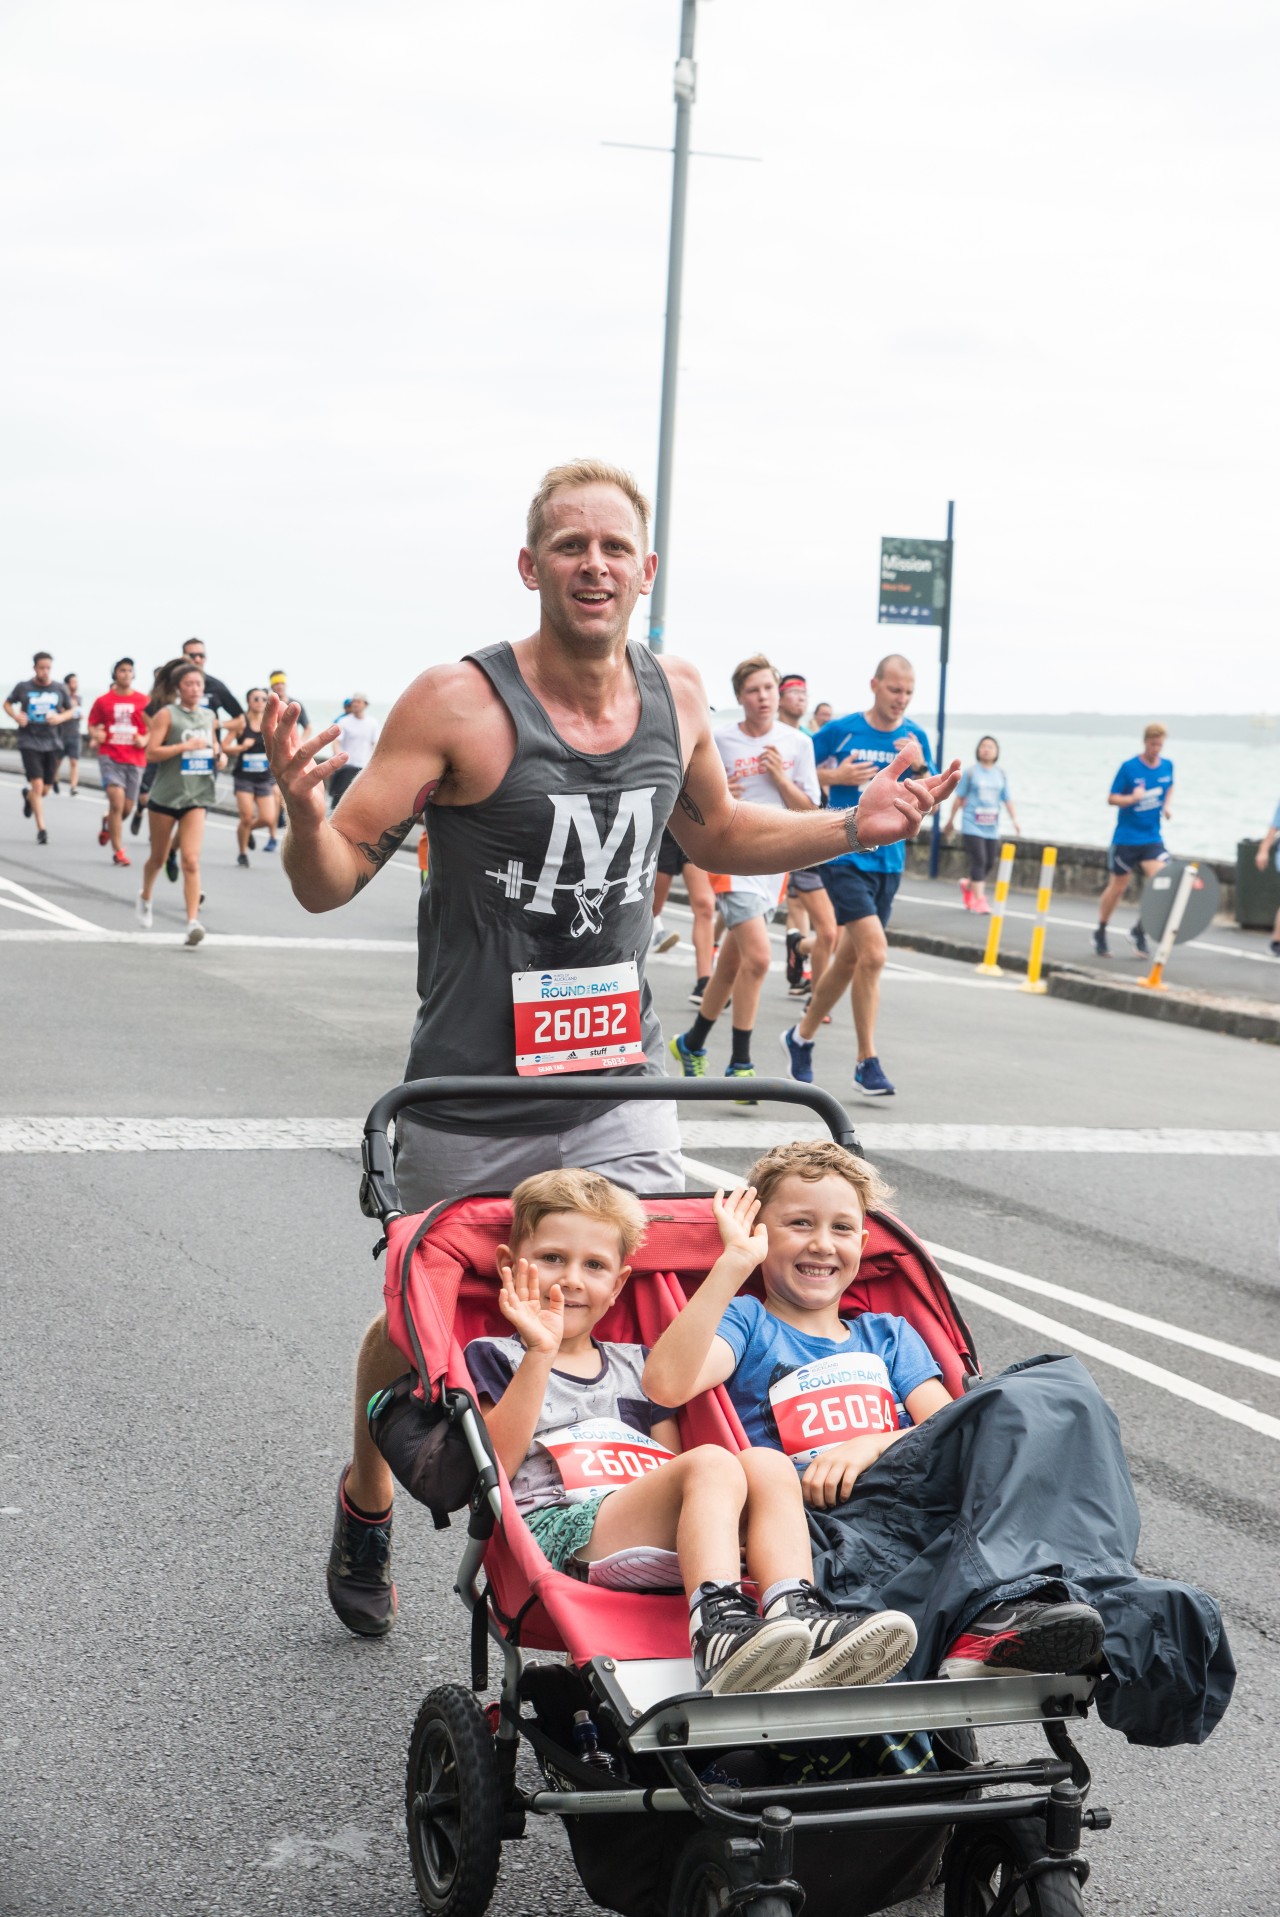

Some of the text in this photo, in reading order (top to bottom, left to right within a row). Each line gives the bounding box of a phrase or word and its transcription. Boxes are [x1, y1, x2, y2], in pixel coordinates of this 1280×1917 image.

[882, 554, 932, 573] Mission
[850, 748, 898, 764] SAMSU
[541, 985, 586, 999] ROUND
[591, 981, 619, 995] BAYS
[534, 1002, 627, 1043] 26032
[589, 1047, 608, 1057] stuff
[601, 1056, 628, 1067] 26032
[799, 1371, 852, 1392] ROUND
[857, 1369, 883, 1385] BAYS
[796, 1394, 895, 1439] 26034
[572, 1430, 623, 1440] ROUND
[626, 1433, 660, 1448] BAYS
